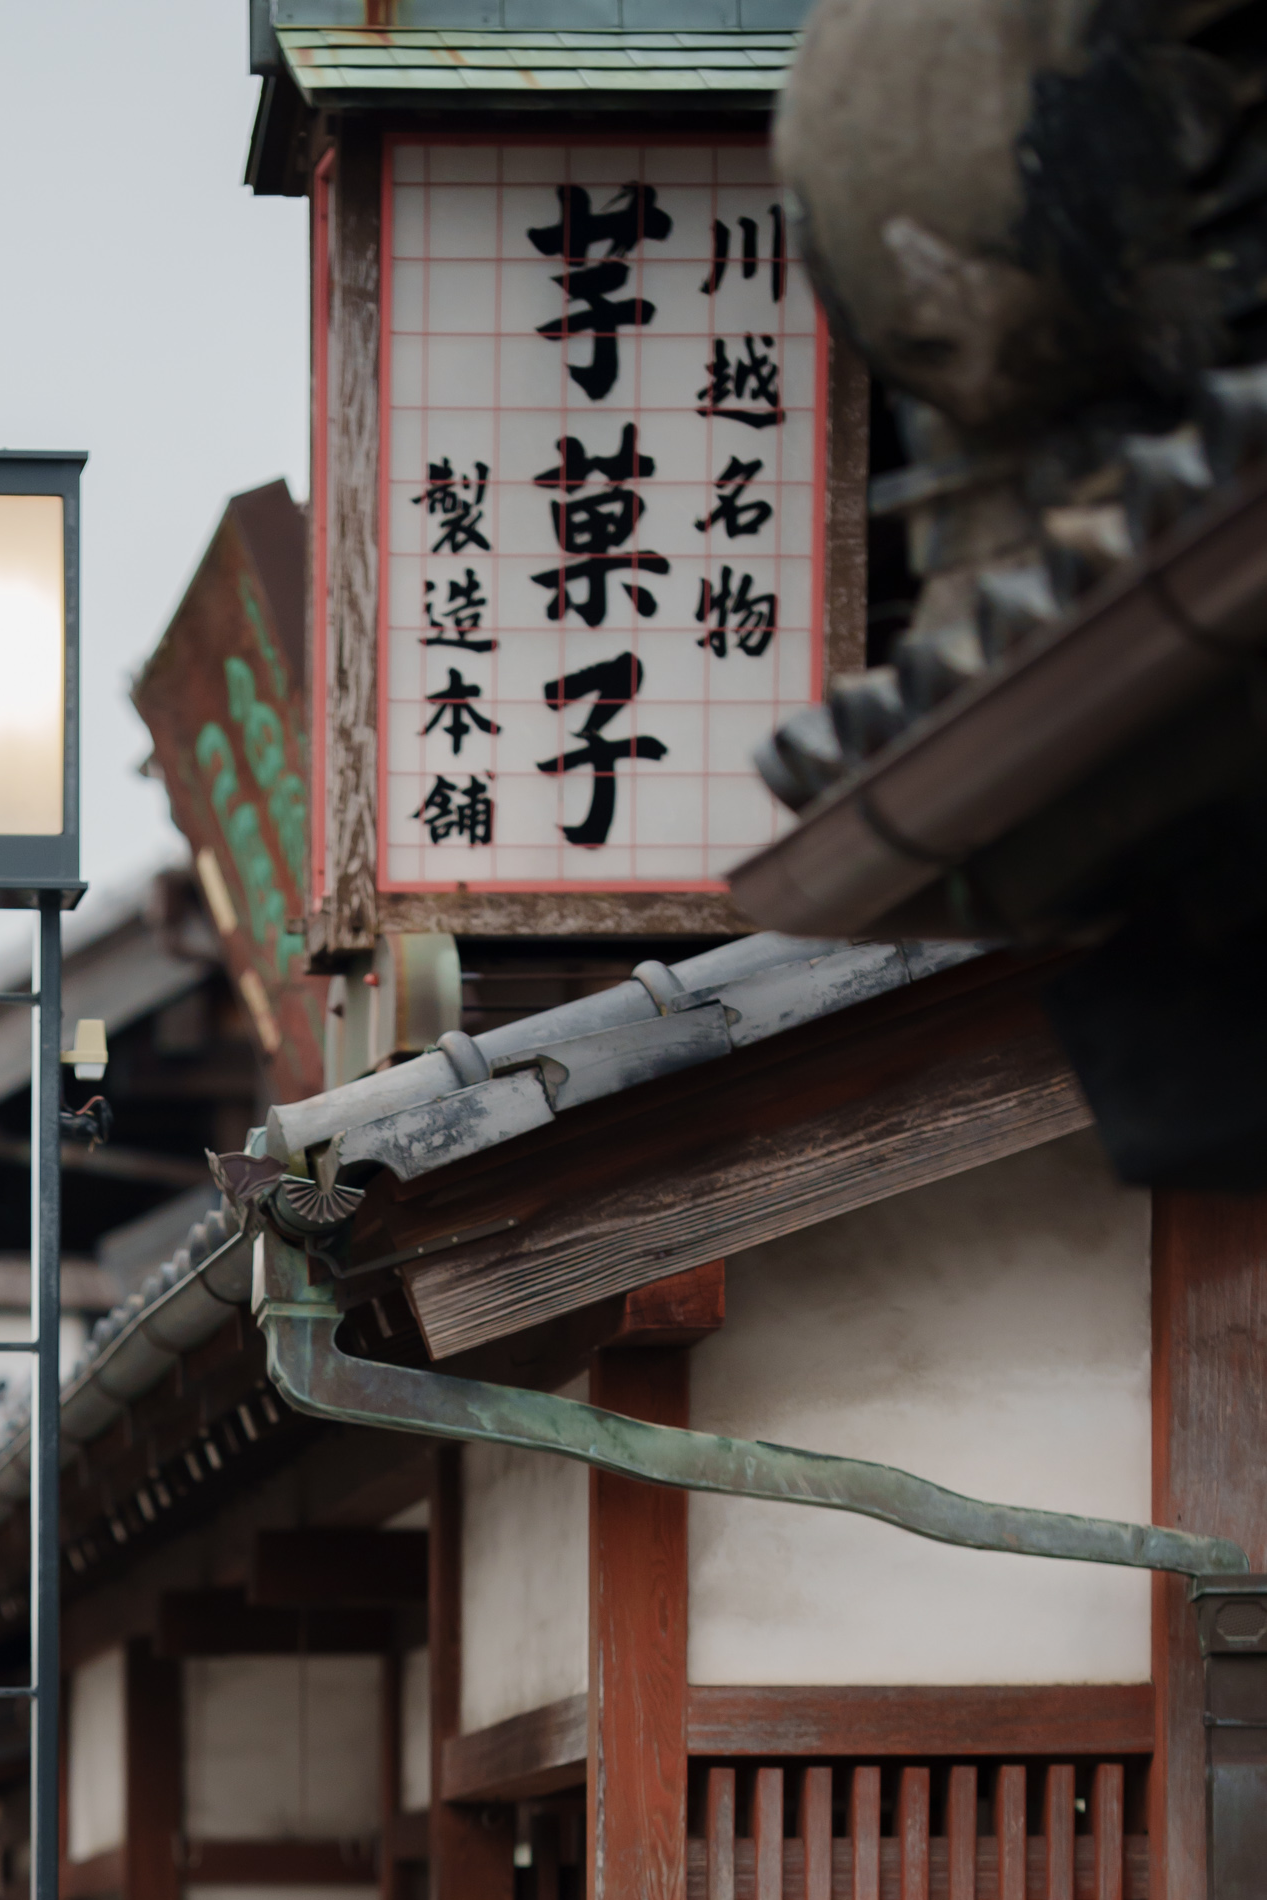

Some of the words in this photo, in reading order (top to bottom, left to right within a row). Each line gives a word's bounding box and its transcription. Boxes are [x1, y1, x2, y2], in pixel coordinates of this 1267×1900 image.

[410, 456, 502, 847] 製造本舗
[527, 180, 673, 849] 芋菓子
[695, 204, 787, 658] 川越名物
